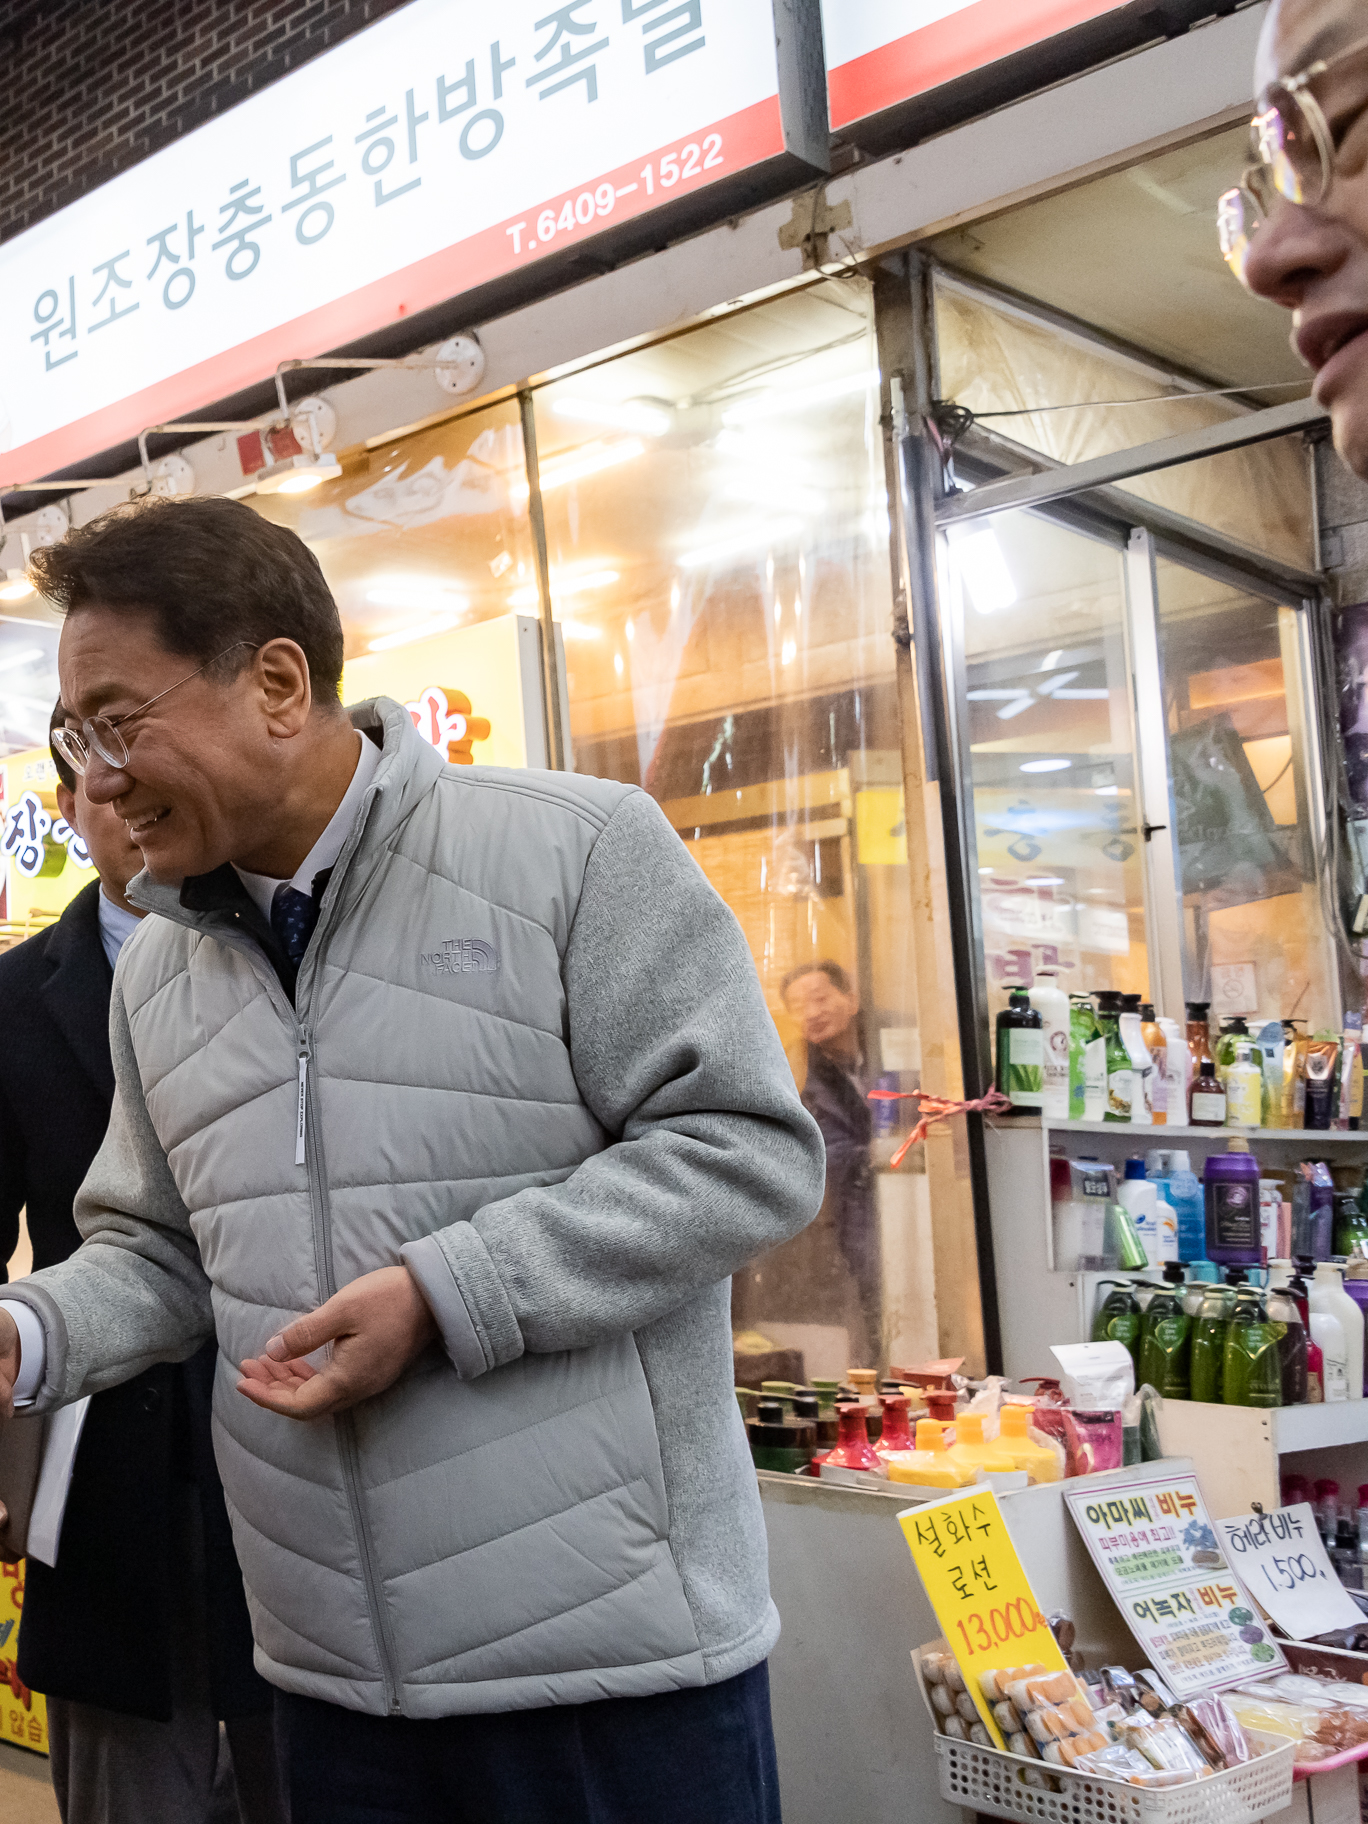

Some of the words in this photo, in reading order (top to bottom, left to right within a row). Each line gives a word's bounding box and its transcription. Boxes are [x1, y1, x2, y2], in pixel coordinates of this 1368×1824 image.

[505, 133, 723, 254] T.6409-1522
[420, 950, 472, 966] NORTH
[442, 938, 472, 951] THE
[435, 961, 472, 975] FACE
[1086, 1497, 1153, 1530] 아마씨
[1155, 1491, 1197, 1518] 비누
[915, 1503, 991, 1558] 설화수
[947, 1554, 998, 1600] 로션
[1133, 1592, 1196, 1624] 어녹자
[1197, 1584, 1237, 1608] 비누
